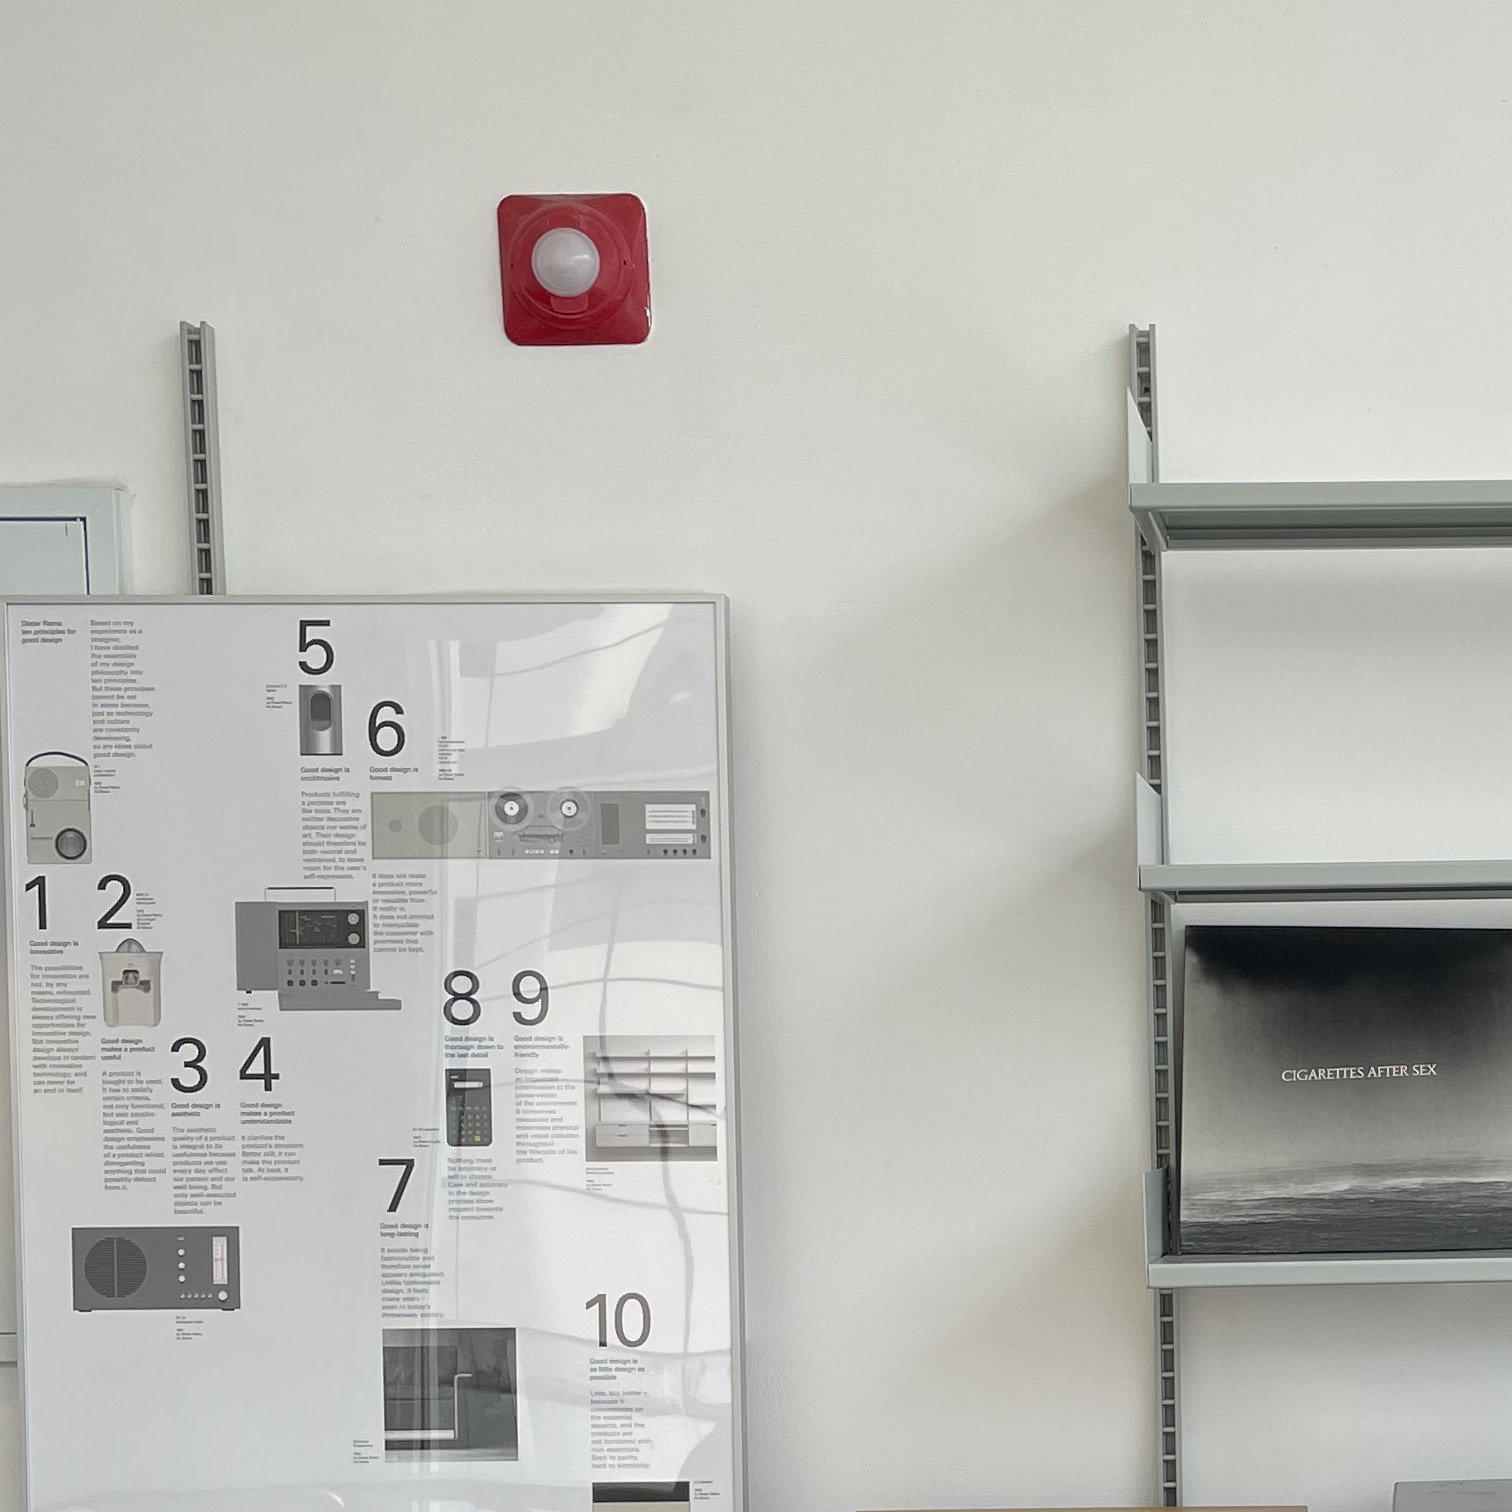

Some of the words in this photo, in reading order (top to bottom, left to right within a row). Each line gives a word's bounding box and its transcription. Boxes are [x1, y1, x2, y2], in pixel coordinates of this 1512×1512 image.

[298, 619, 335, 676] 5
[368, 700, 406, 757] 6
[24, 875, 48, 930] 1
[96, 873, 133, 930] 2
[443, 969, 482, 1026] 8
[511, 969, 550, 1026] 9
[170, 1037, 208, 1093] 3
[239, 1036, 281, 1092] 4
[1282, 1067, 1364, 1081] CIGARETTES
[1367, 1065, 1409, 1077] AFTER
[1412, 1064, 1437, 1076] SEX
[378, 1158, 415, 1213] 7
[585, 1292, 651, 1348] 10
